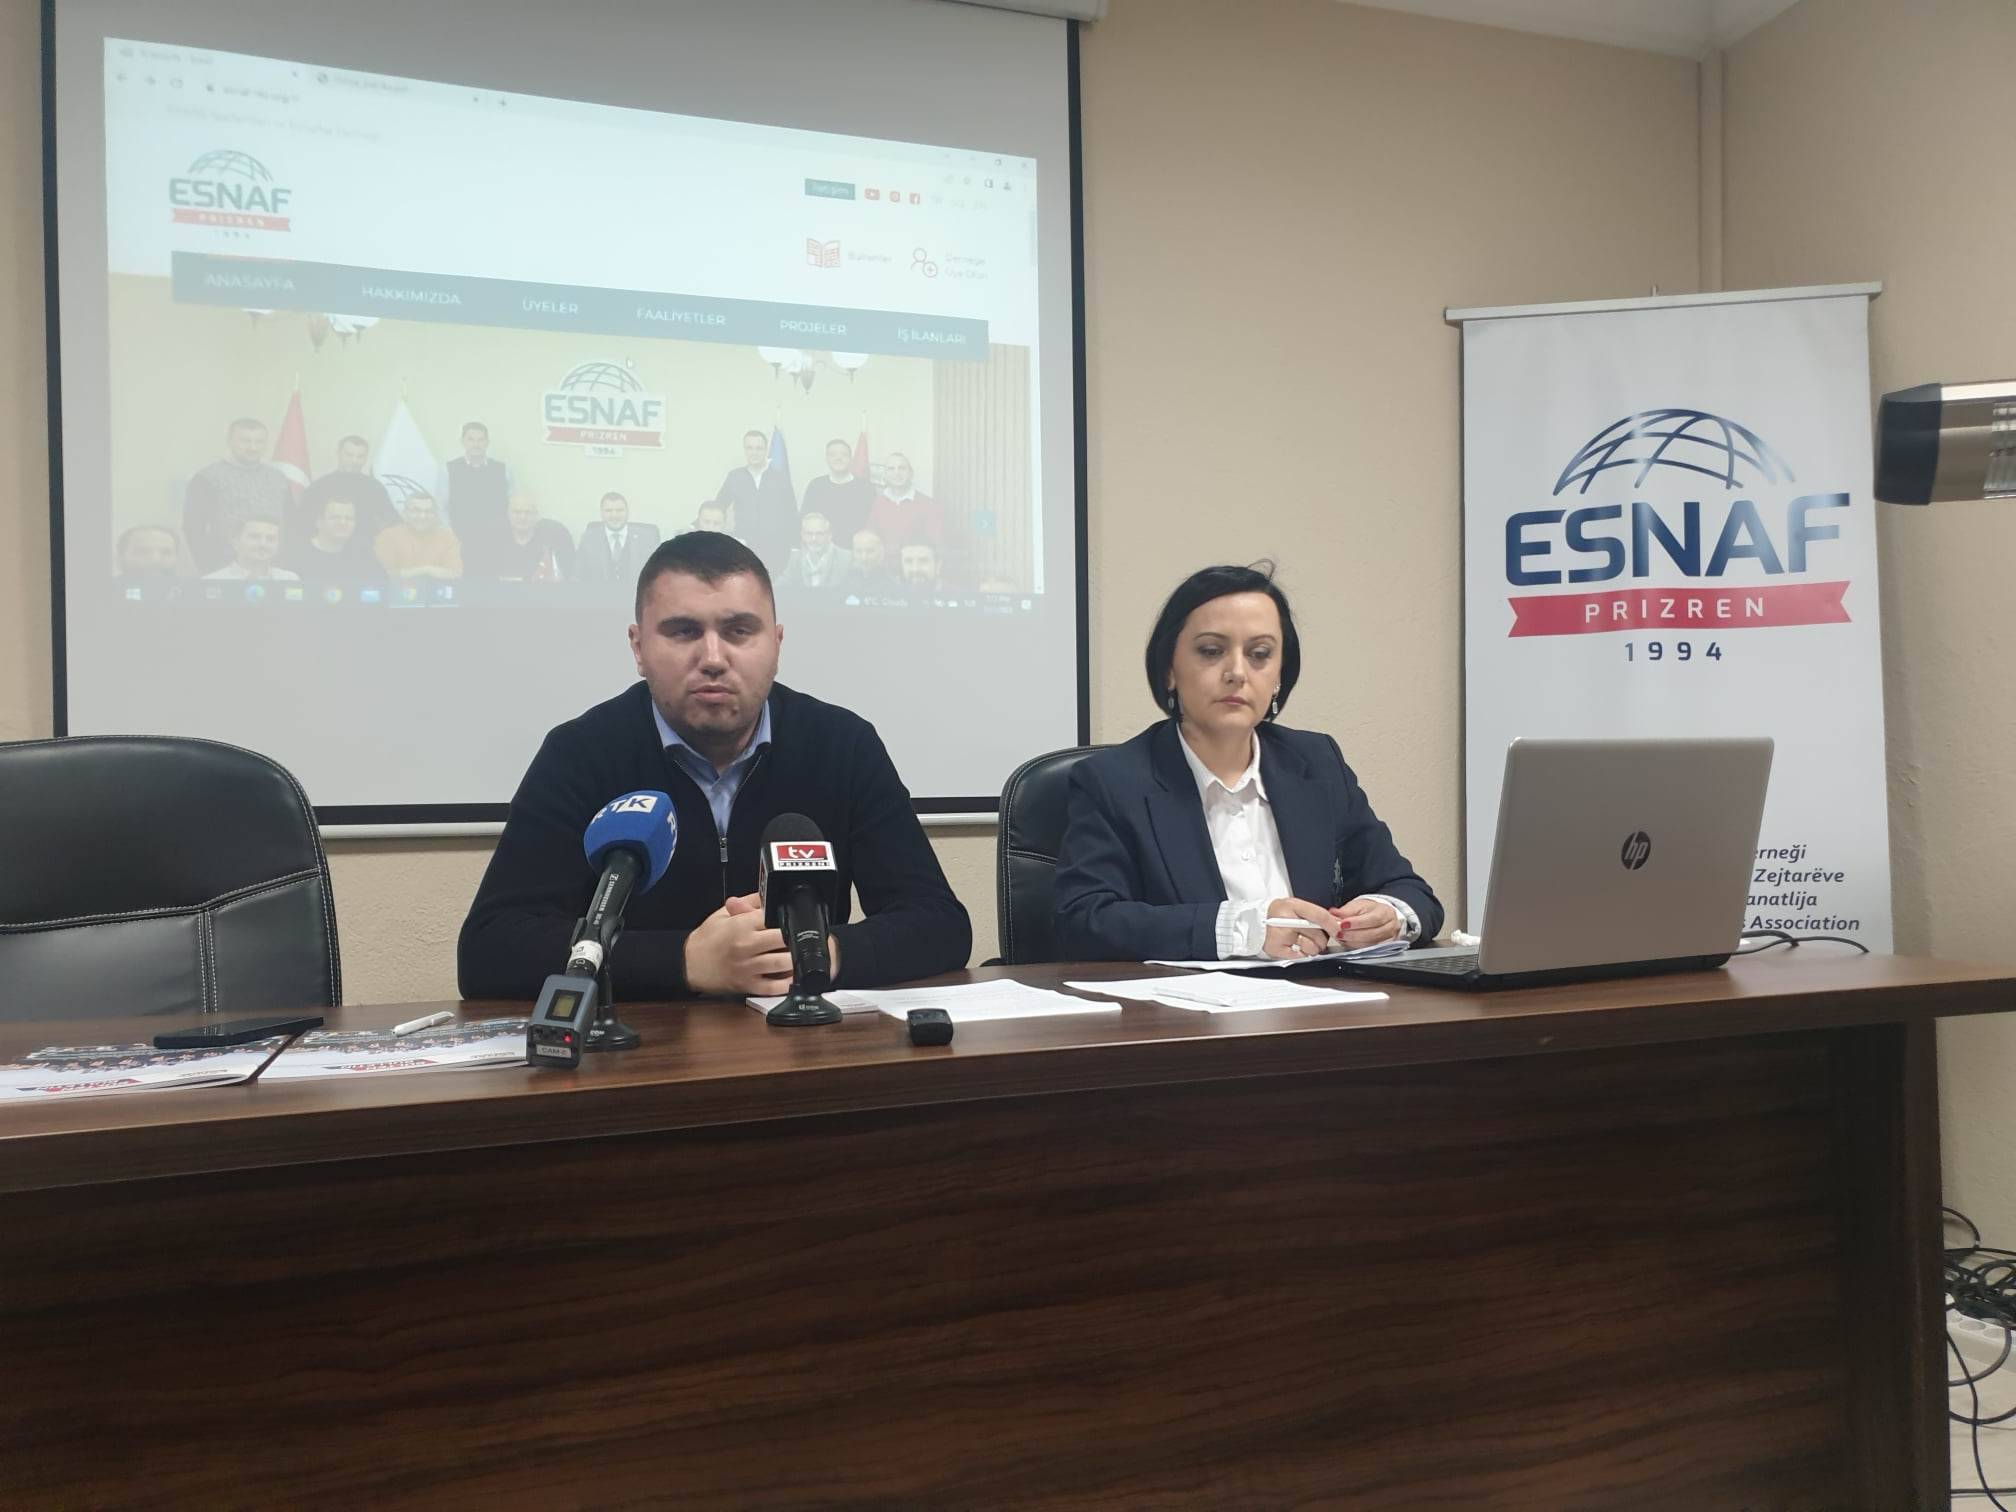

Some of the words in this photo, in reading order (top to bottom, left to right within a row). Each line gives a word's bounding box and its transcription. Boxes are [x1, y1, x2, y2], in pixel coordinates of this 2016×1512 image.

[169, 178, 292, 213] ESNAF
[205, 273, 296, 292] ANASAYFA
[361, 281, 462, 306] HAKKIMIZDA
[780, 319, 848, 336] PROJELER
[545, 394, 662, 427] ESNAF
[1505, 492, 1851, 586] ESNAF
[1584, 597, 1766, 624] PRIZREN
[1624, 641, 1723, 663] 1994
[590, 796, 649, 825] RTK
[788, 846, 815, 858] tv
[1622, 831, 1651, 870] hp
[1753, 867, 1845, 887] Zejtarëve
[1750, 915, 1860, 931] Association
